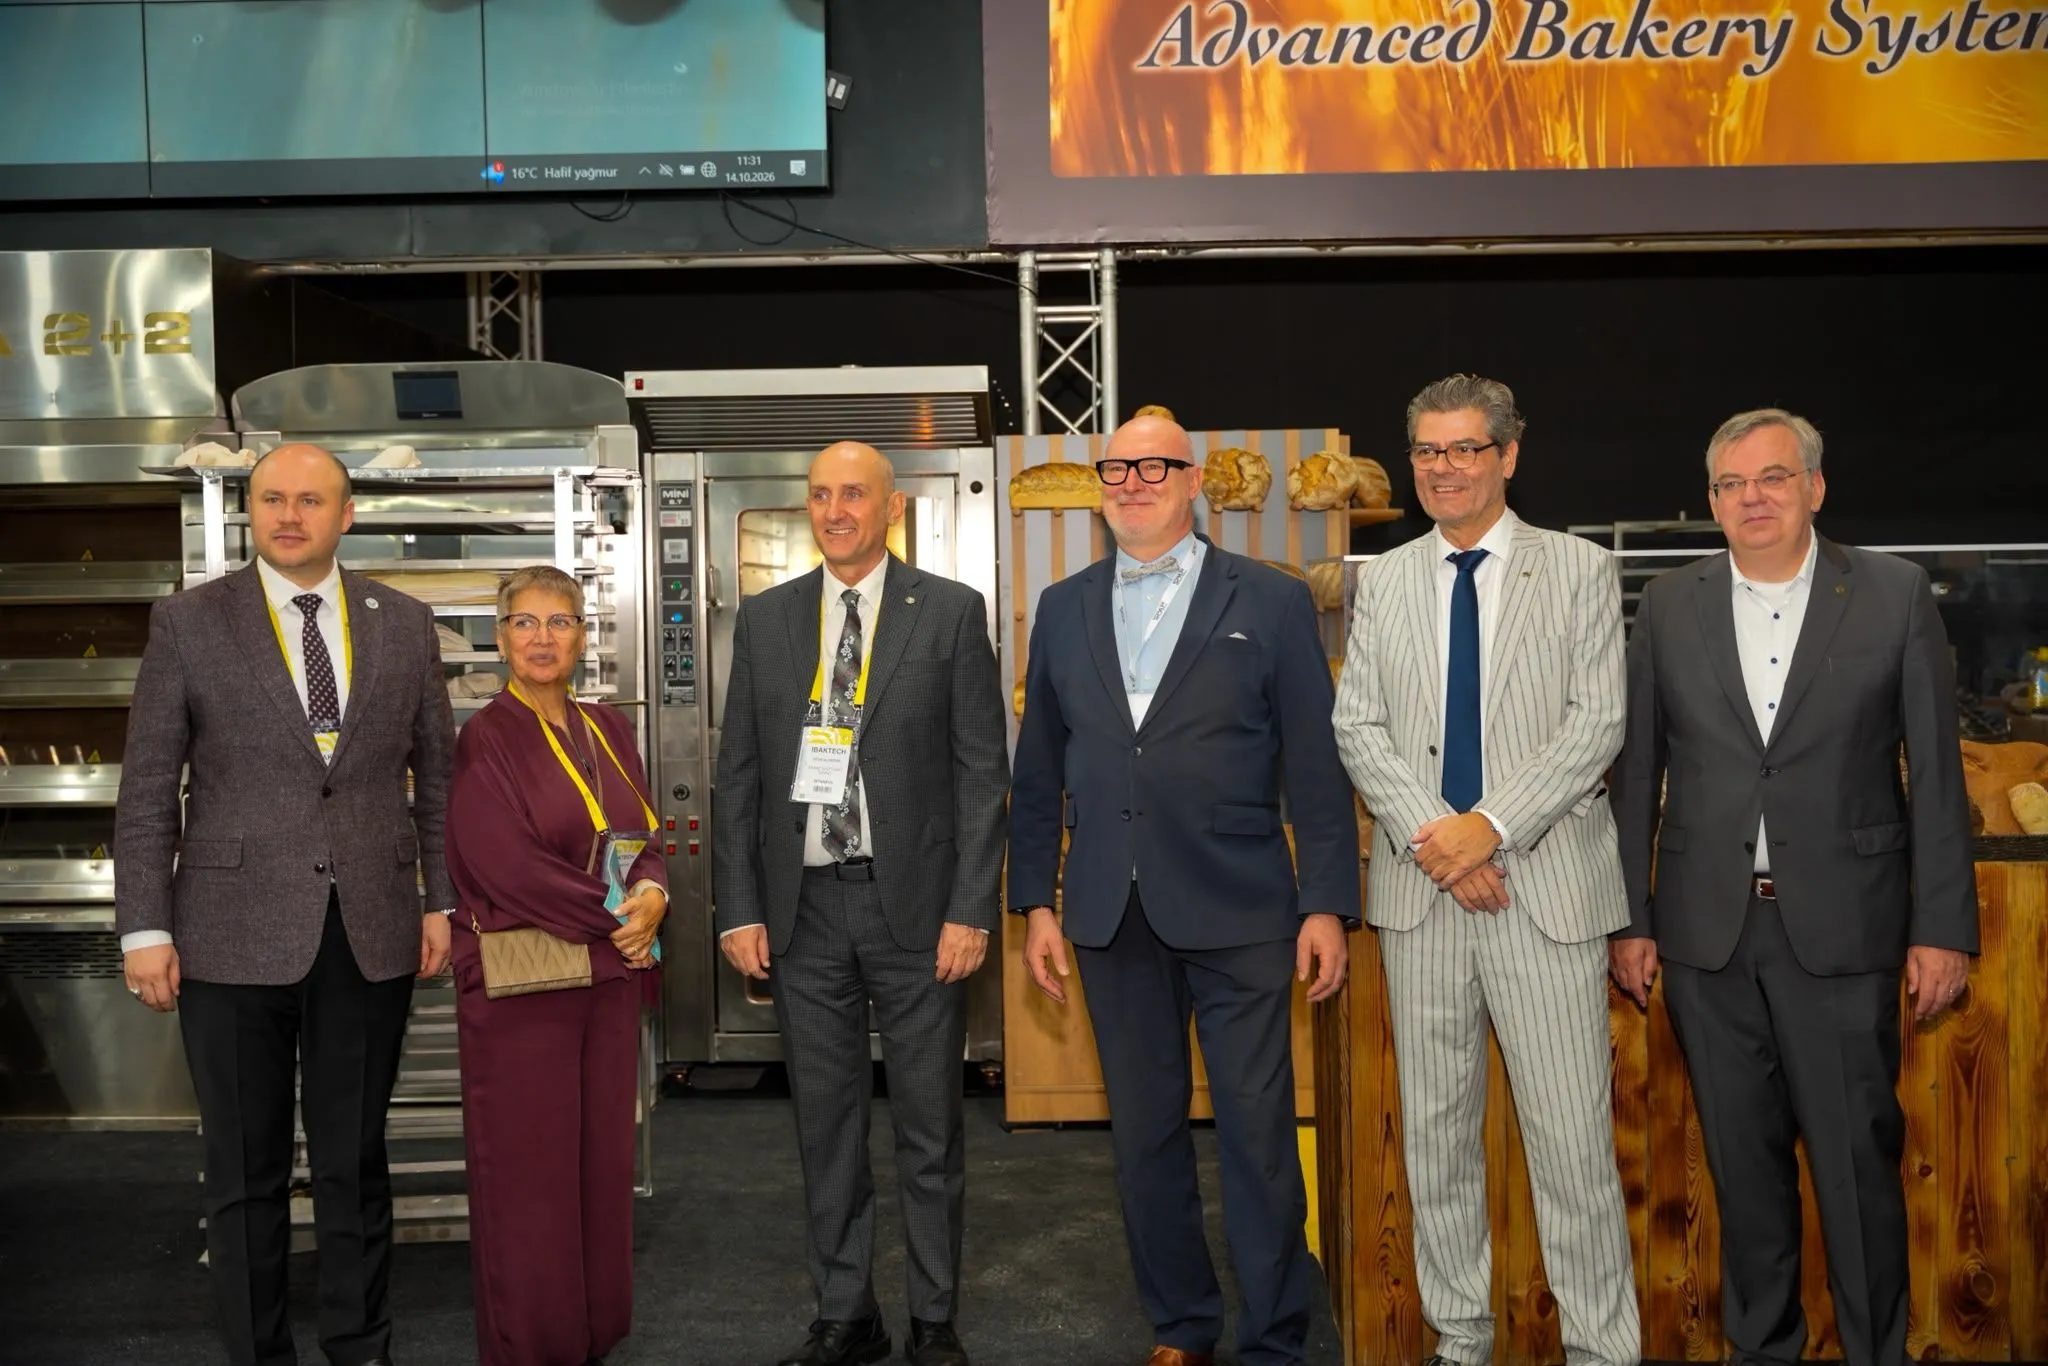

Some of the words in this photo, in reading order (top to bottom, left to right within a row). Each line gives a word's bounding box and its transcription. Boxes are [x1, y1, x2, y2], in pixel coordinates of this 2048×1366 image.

[1137, 0, 1493, 68] Advanced
[1507, 0, 1794, 77] Bakery
[737, 156, 761, 166] 11:31
[512, 167, 538, 179] 16°C
[574, 168, 618, 181] yağmur
[725, 172, 776, 182] 14.10.2026
